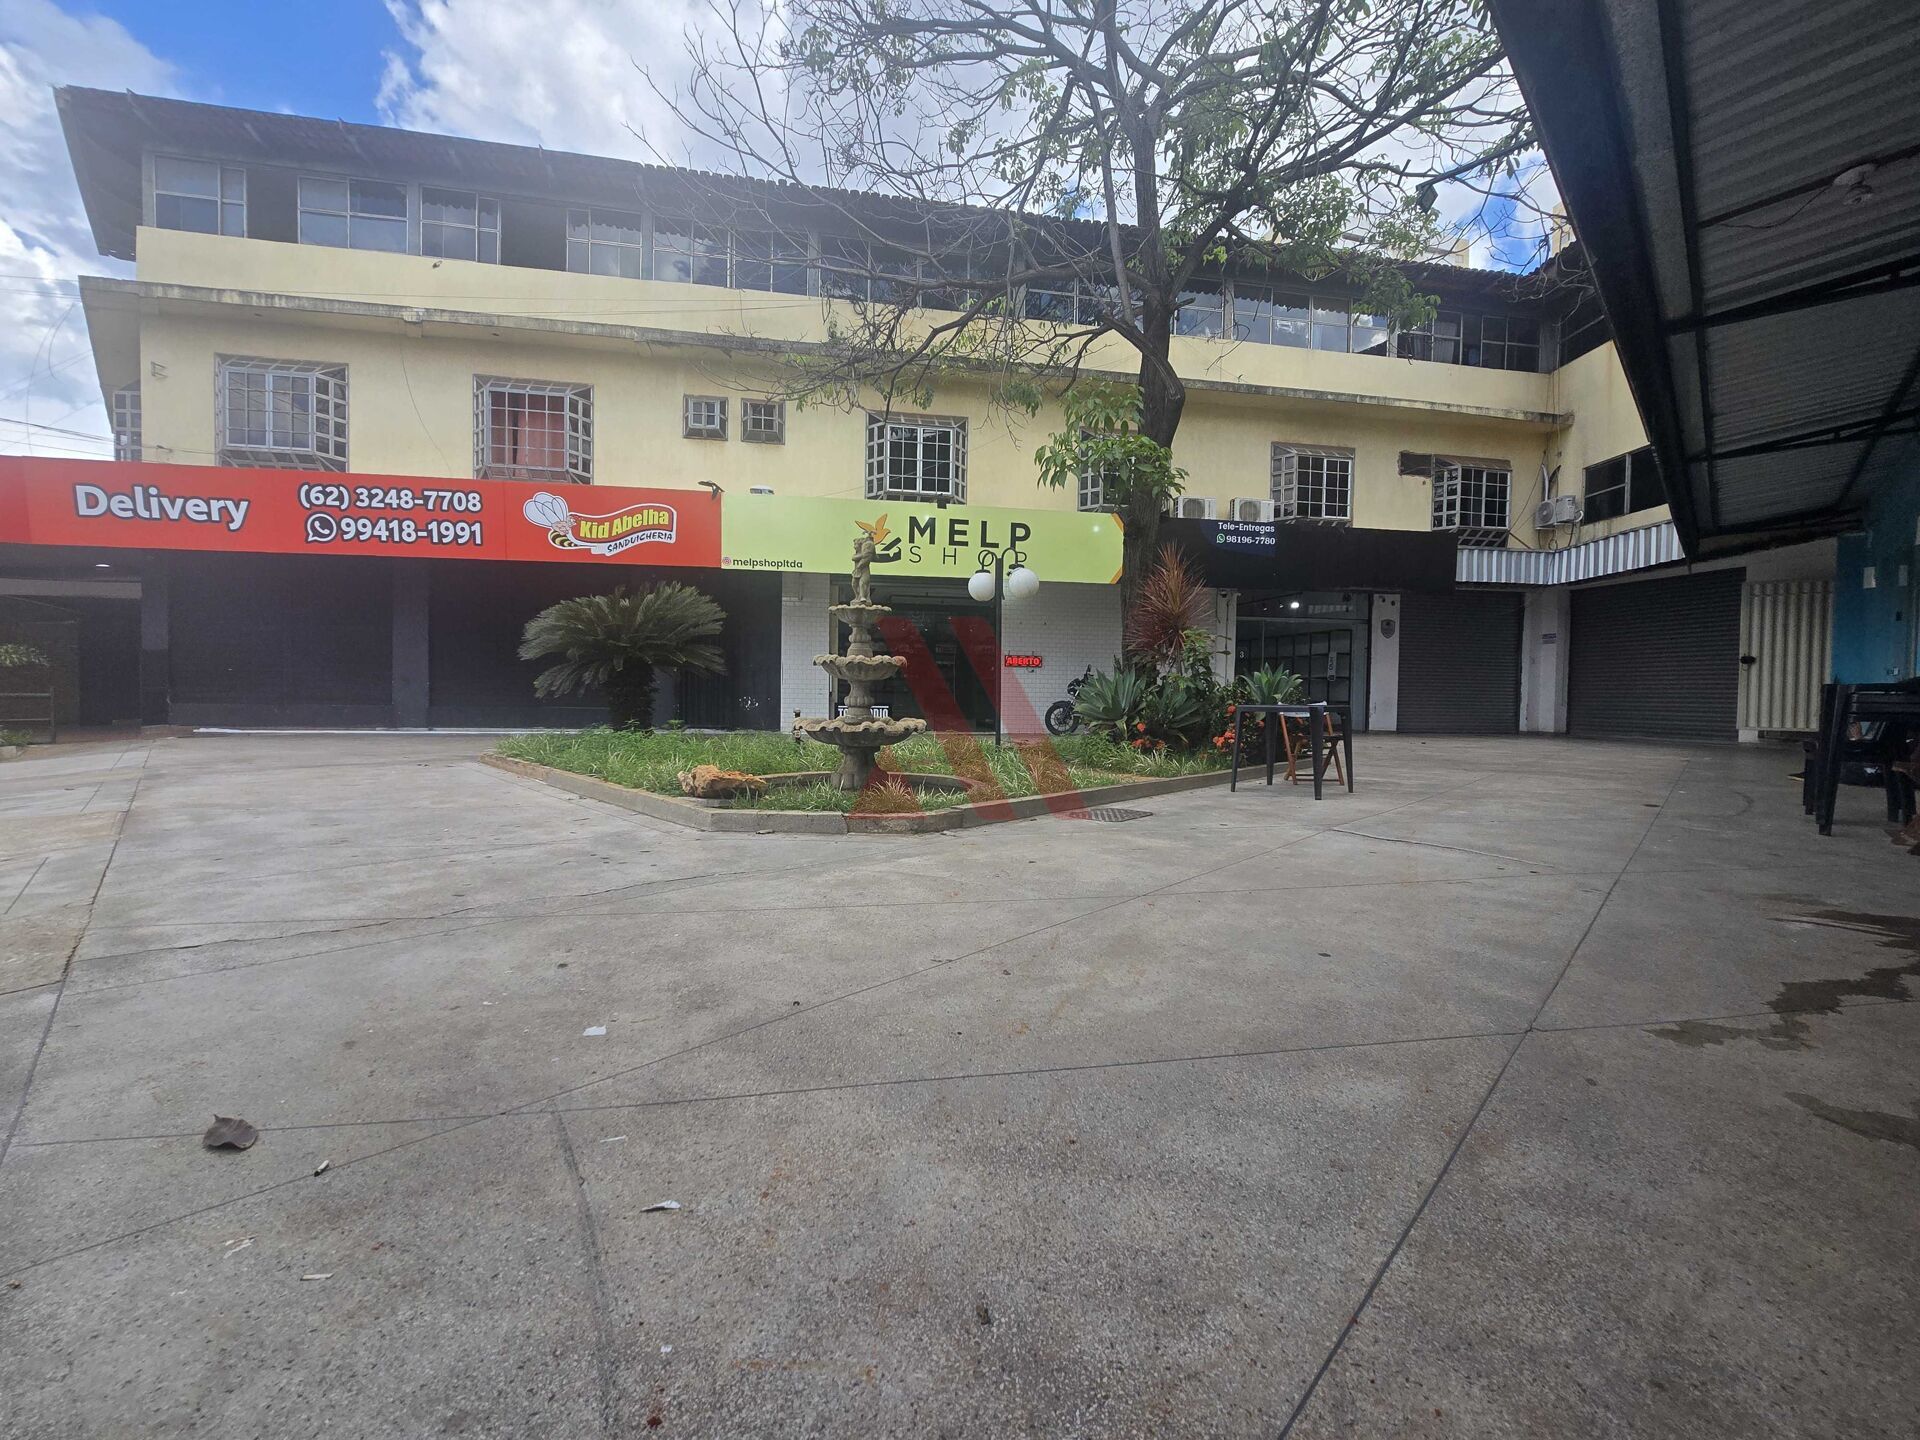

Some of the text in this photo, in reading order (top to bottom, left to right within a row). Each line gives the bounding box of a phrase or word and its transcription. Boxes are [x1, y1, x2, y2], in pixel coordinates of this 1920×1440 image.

[74, 484, 250, 531] Delivery
[299, 483, 483, 513] (62) 3248-7708
[339, 516, 483, 546] 99418-1991
[579, 509, 669, 538] Kid Abelha
[908, 516, 1031, 549] MELP
[1217, 522, 1275, 534] Tele-Entregas
[607, 531, 673, 553] SANDUICHERIA
[1226, 535, 1276, 545] 98196-7780
[732, 558, 803, 569] melpshopltda
[908, 545, 1027, 567] SHOP
[1006, 657, 1040, 665] ABERTO
